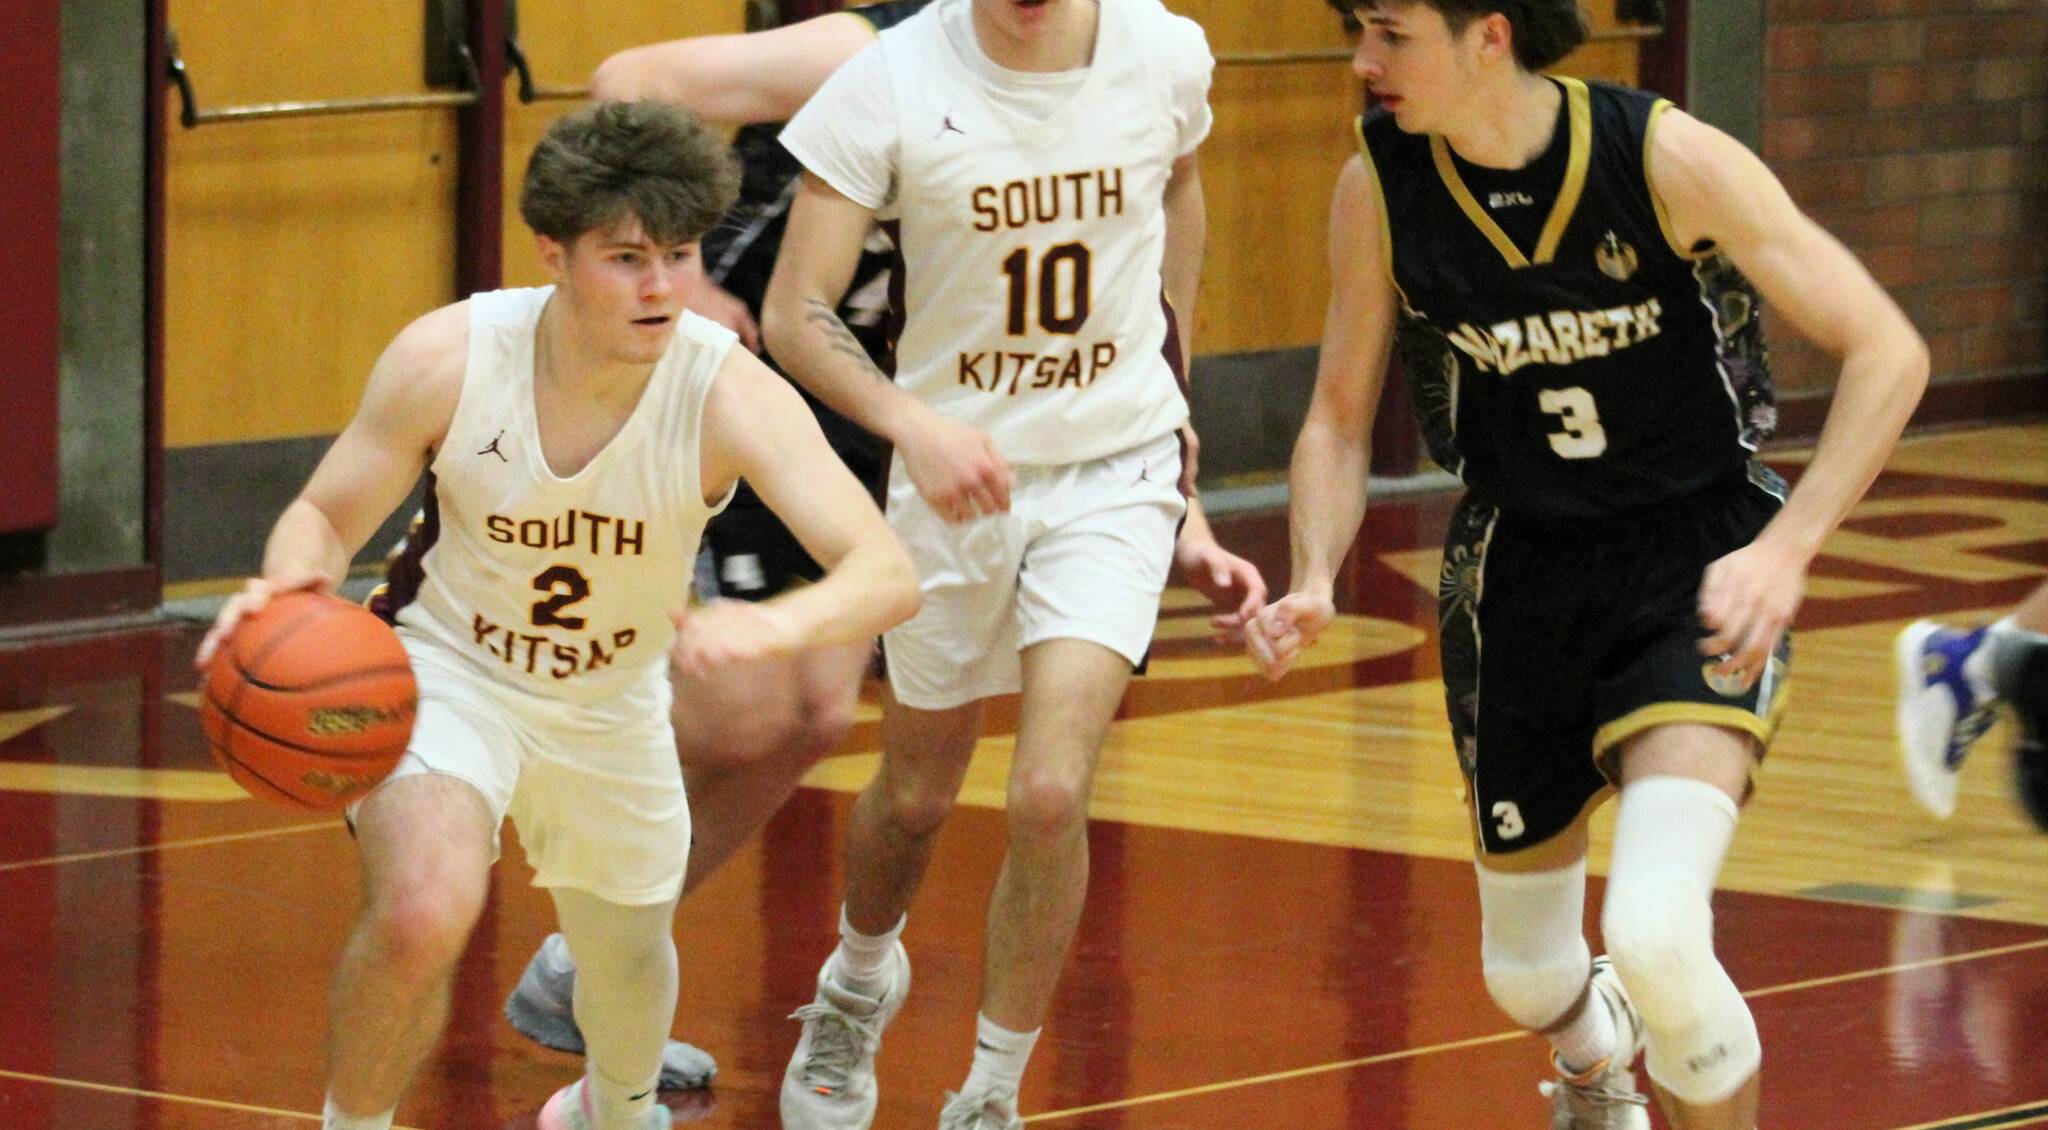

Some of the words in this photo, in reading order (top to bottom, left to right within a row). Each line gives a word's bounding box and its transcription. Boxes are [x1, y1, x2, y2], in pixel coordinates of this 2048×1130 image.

[971, 167, 1124, 233] SOUTH
[1001, 239, 1092, 337] 10
[957, 341, 1118, 396] KITSAP
[1538, 386, 1608, 460] 3
[486, 508, 645, 556] SOUTH
[531, 564, 592, 631] 2
[472, 612, 637, 680] KITSAP
[1492, 801, 1525, 839] 3
